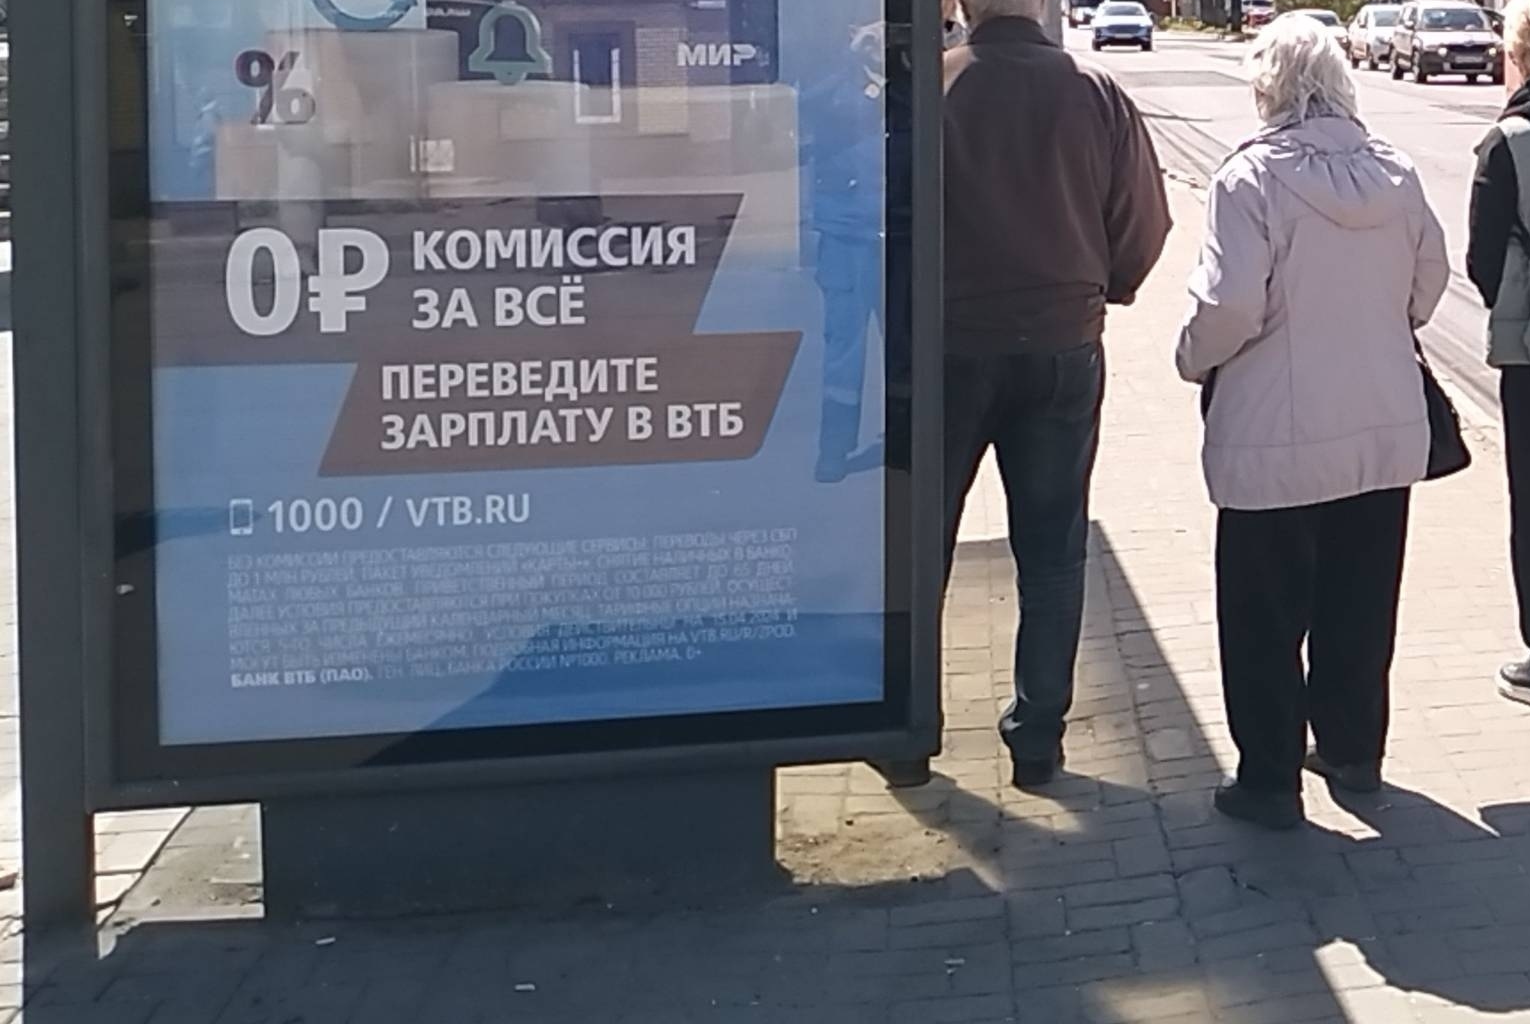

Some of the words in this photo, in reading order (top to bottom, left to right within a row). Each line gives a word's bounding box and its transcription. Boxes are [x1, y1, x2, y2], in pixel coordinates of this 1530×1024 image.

[677, 43, 757, 67] МИР
[412, 225, 697, 271] КОМИССИЯ
[412, 287, 478, 328] ЗА
[495, 277, 586, 327] ВСЁ
[381, 357, 659, 402] ПЕРЕВЕДИТЕ
[381, 407, 612, 451] ЗАРПЛАТУ
[627, 407, 652, 440] В
[667, 402, 744, 439] ВТБ
[267, 498, 364, 532] 1000
[405, 493, 531, 528] VTB.RU
[229, 671, 279, 689] БАНК
